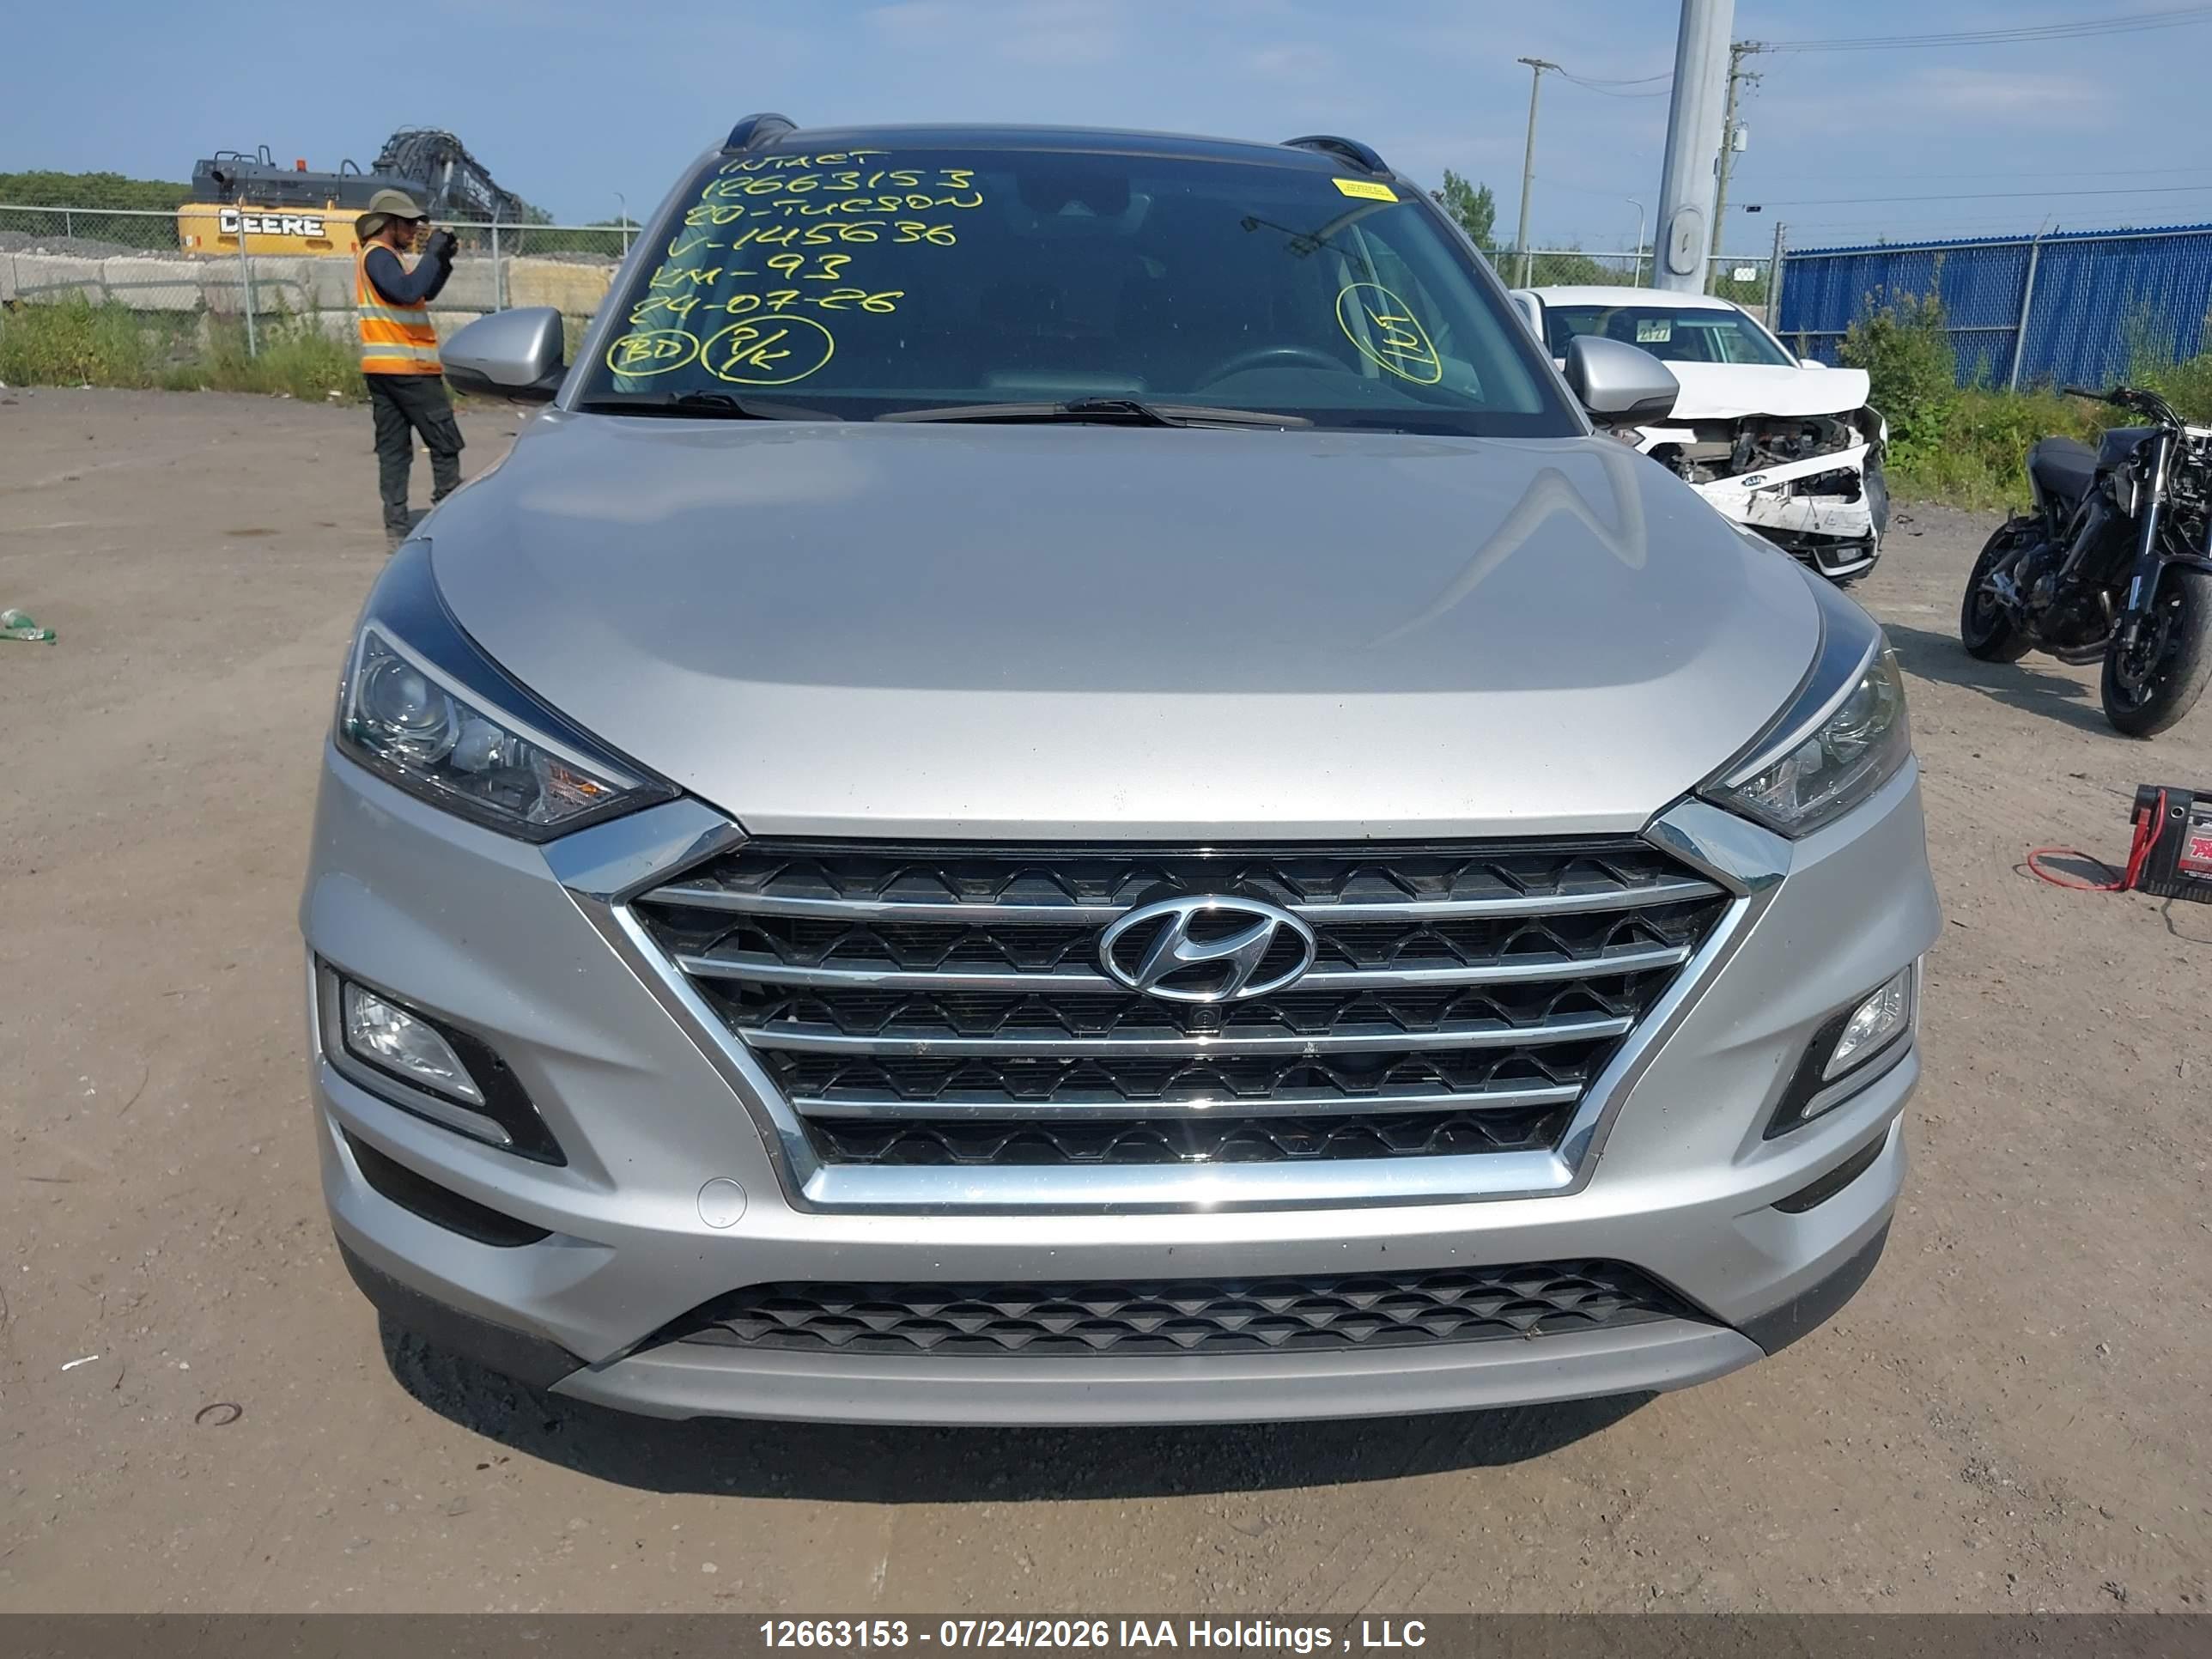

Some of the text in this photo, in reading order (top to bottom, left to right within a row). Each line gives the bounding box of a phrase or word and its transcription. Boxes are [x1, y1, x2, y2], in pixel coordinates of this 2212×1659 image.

[718, 150, 892, 174] INTACT
[701, 169, 975, 199] 12663153
[220, 208, 325, 237] DEERE
